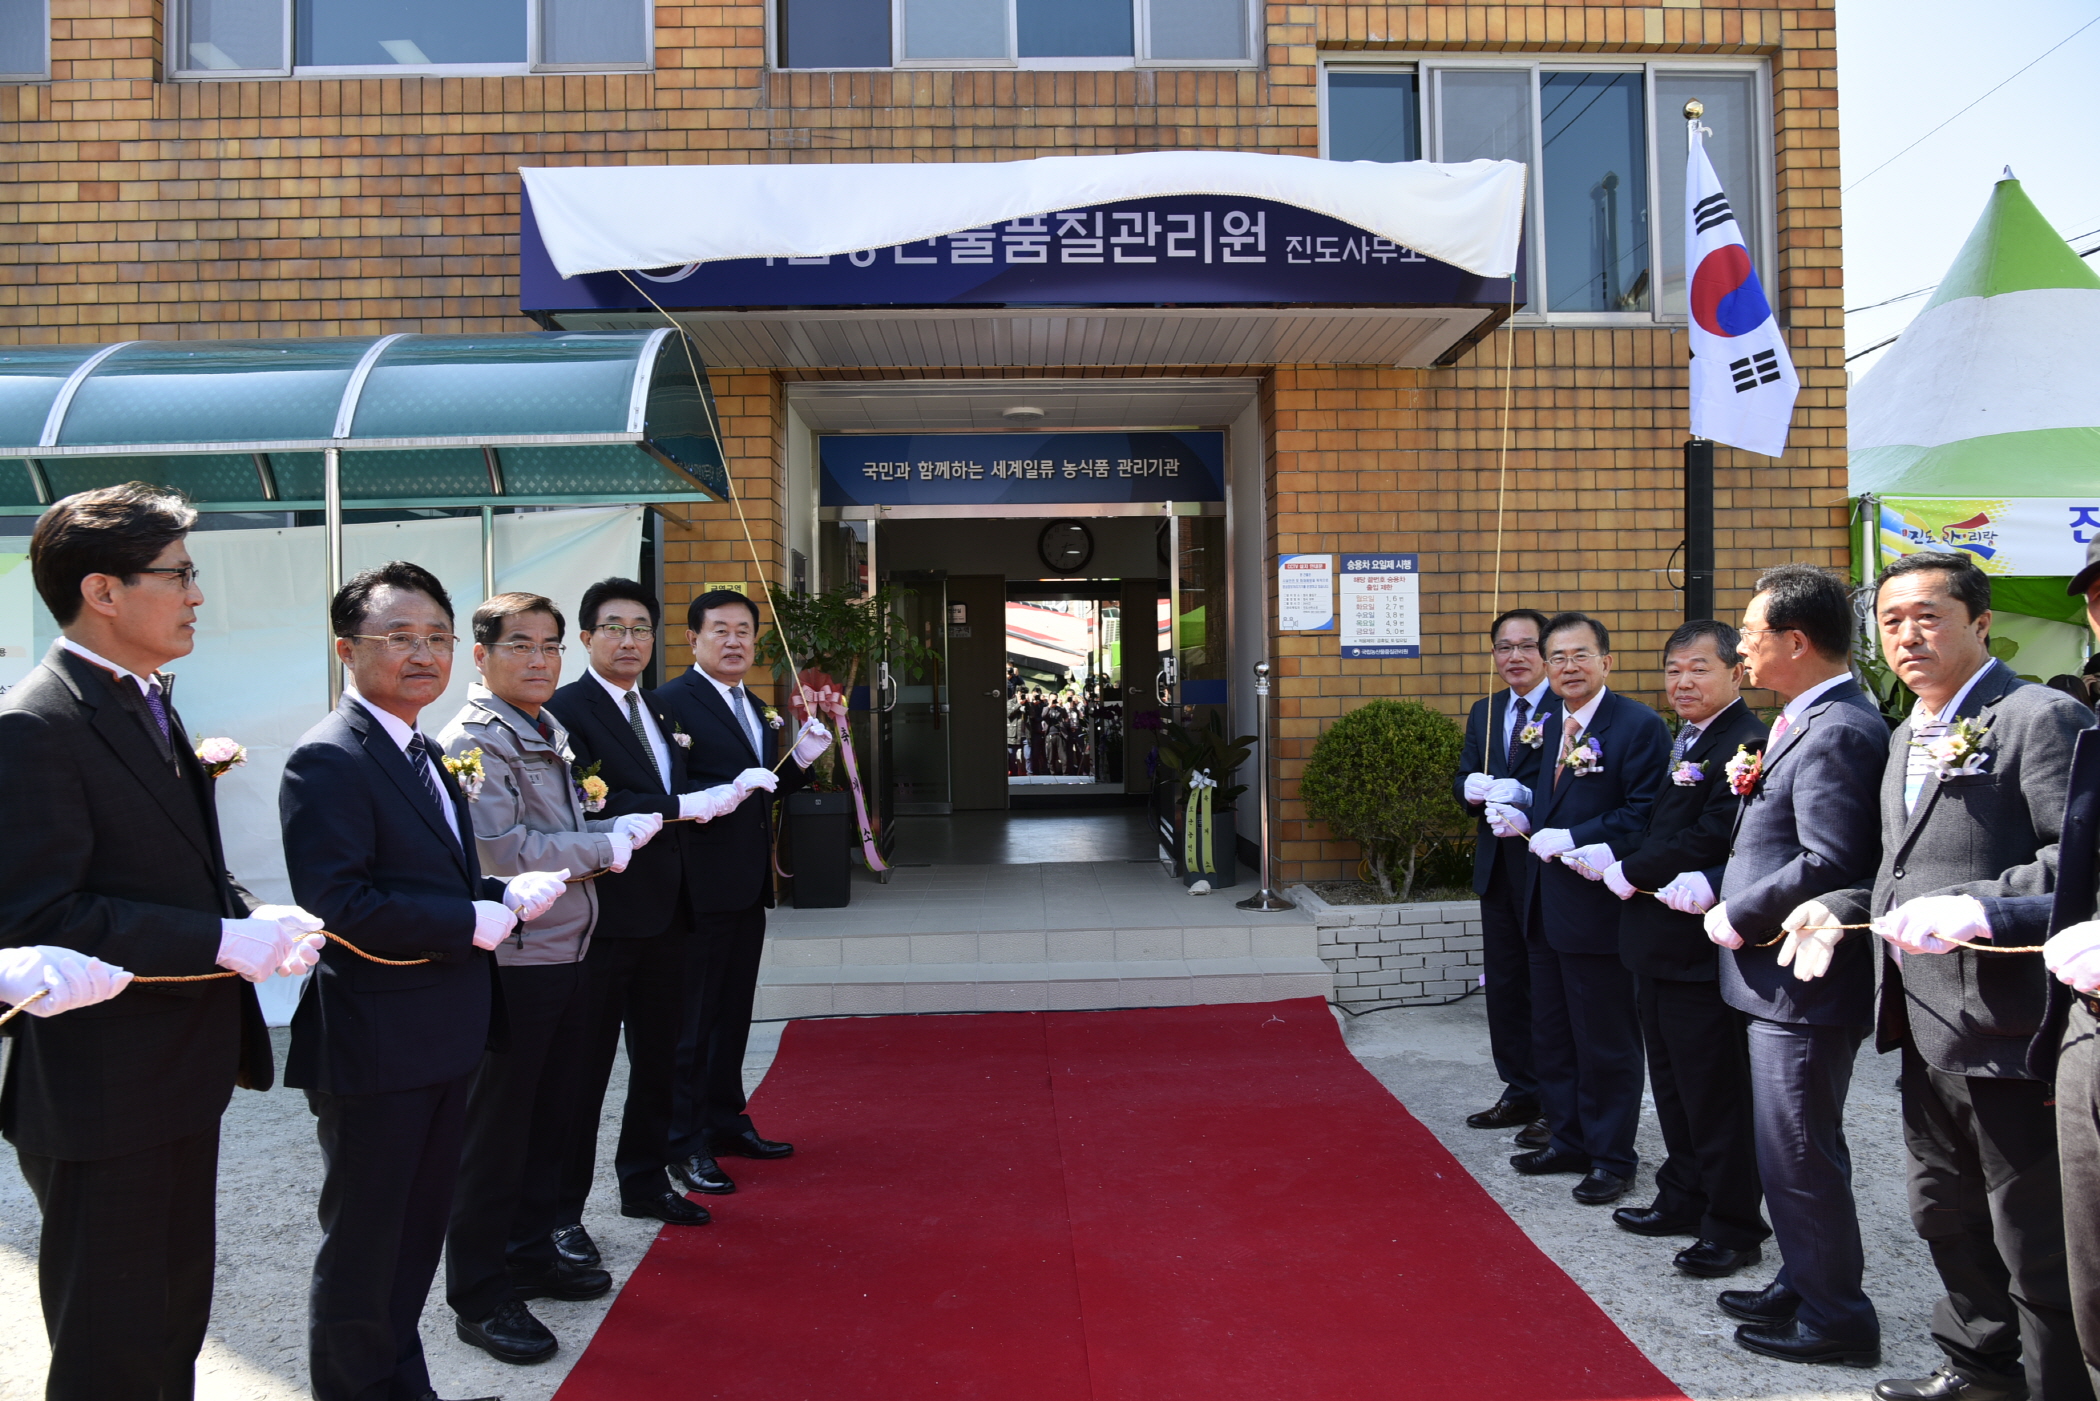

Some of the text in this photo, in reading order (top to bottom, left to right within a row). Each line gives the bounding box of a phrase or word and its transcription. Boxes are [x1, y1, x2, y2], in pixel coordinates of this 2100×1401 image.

[765, 209, 1267, 267] 물품질관리원
[862, 458, 1180, 481] 국민과 함께하는 세계일류 농식품 관리기관
[1347, 559, 1412, 570] 승용차 요일제 시행
[1356, 619, 1375, 627] 목요일
[1356, 627, 1375, 635] 금요일
[1361, 648, 1409, 656] 국립농산물품질관리원
